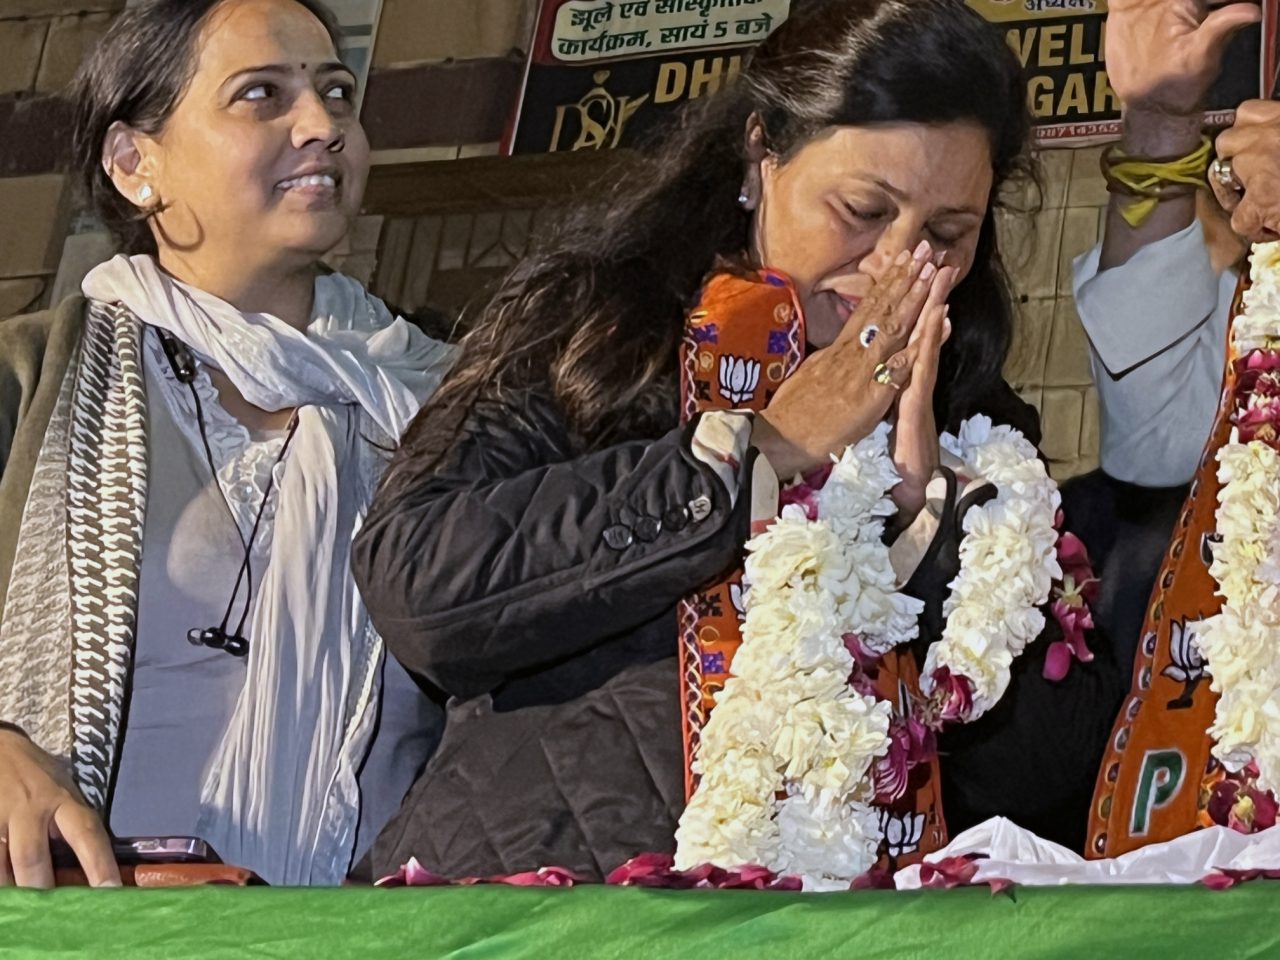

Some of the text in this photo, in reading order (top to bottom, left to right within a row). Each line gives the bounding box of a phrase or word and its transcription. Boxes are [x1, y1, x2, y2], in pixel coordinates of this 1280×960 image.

[557, 12, 775, 56] कार्यक्रम, सायं 5 बजे
[569, 1, 614, 32] झूले
